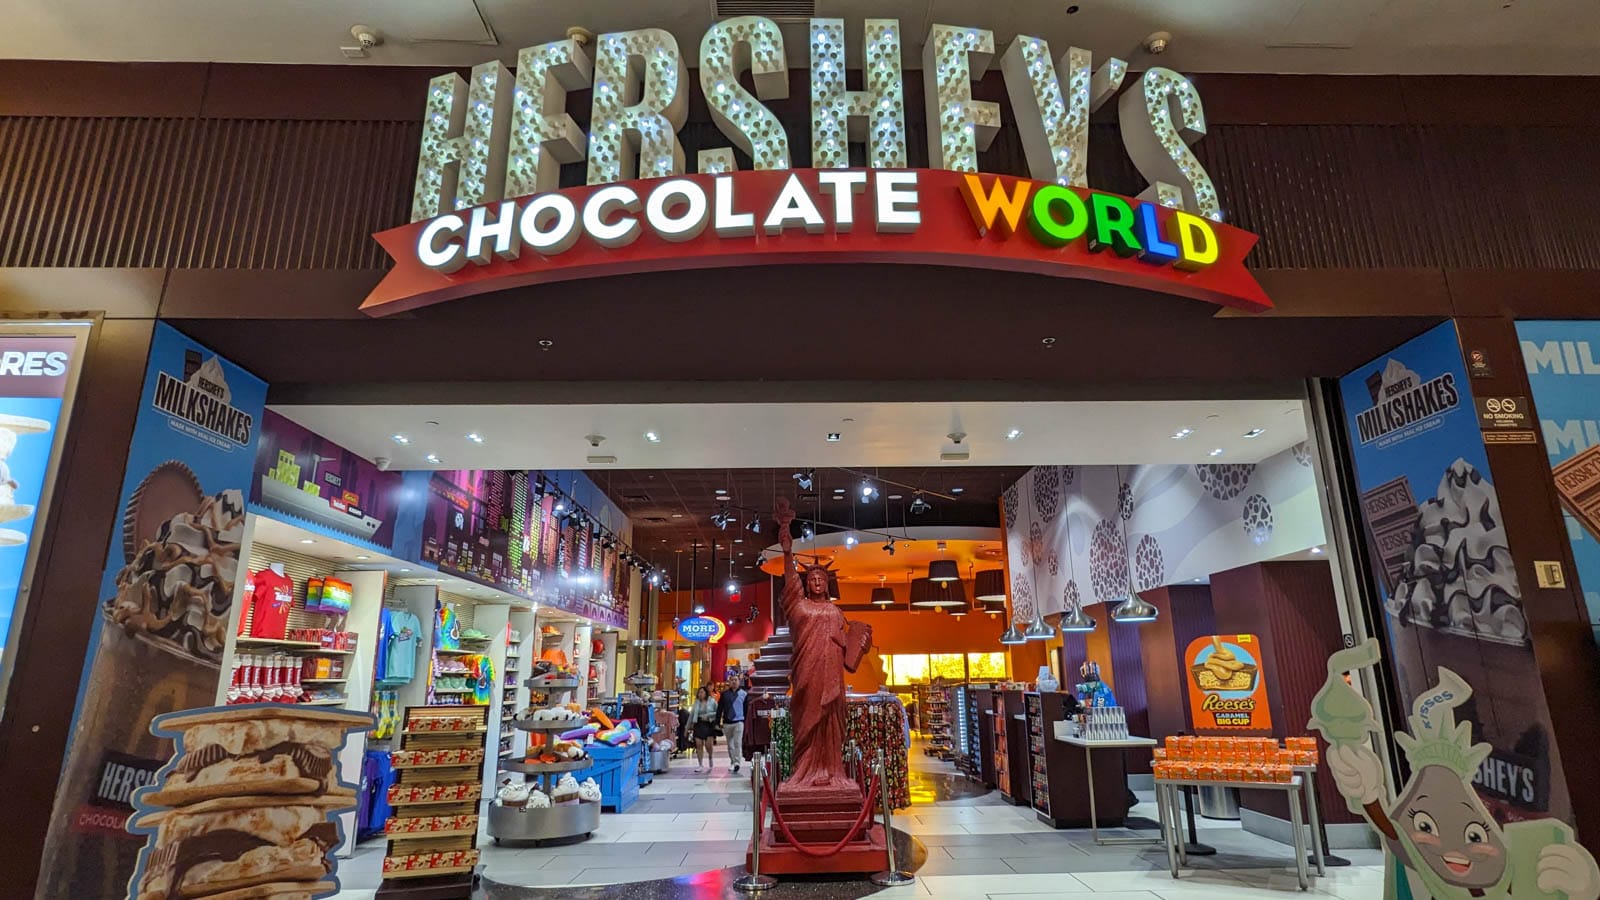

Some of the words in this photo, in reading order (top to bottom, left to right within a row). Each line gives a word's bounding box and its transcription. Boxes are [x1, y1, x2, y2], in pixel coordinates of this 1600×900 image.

[411, 16, 1222, 224] HERSHEY'S
[417, 171, 920, 269] CHOCOLATE
[963, 173, 1219, 265] WORLD
[154, 372, 252, 445] MILKSHAKES
[198, 376, 225, 399] HERSHEY'S
[1356, 374, 1458, 443] MILKSHAKES
[1384, 376, 1413, 398] HERSHEY'S
[1202, 694, 1256, 711] Reese's
[80, 813, 126, 829] CHOCOL
